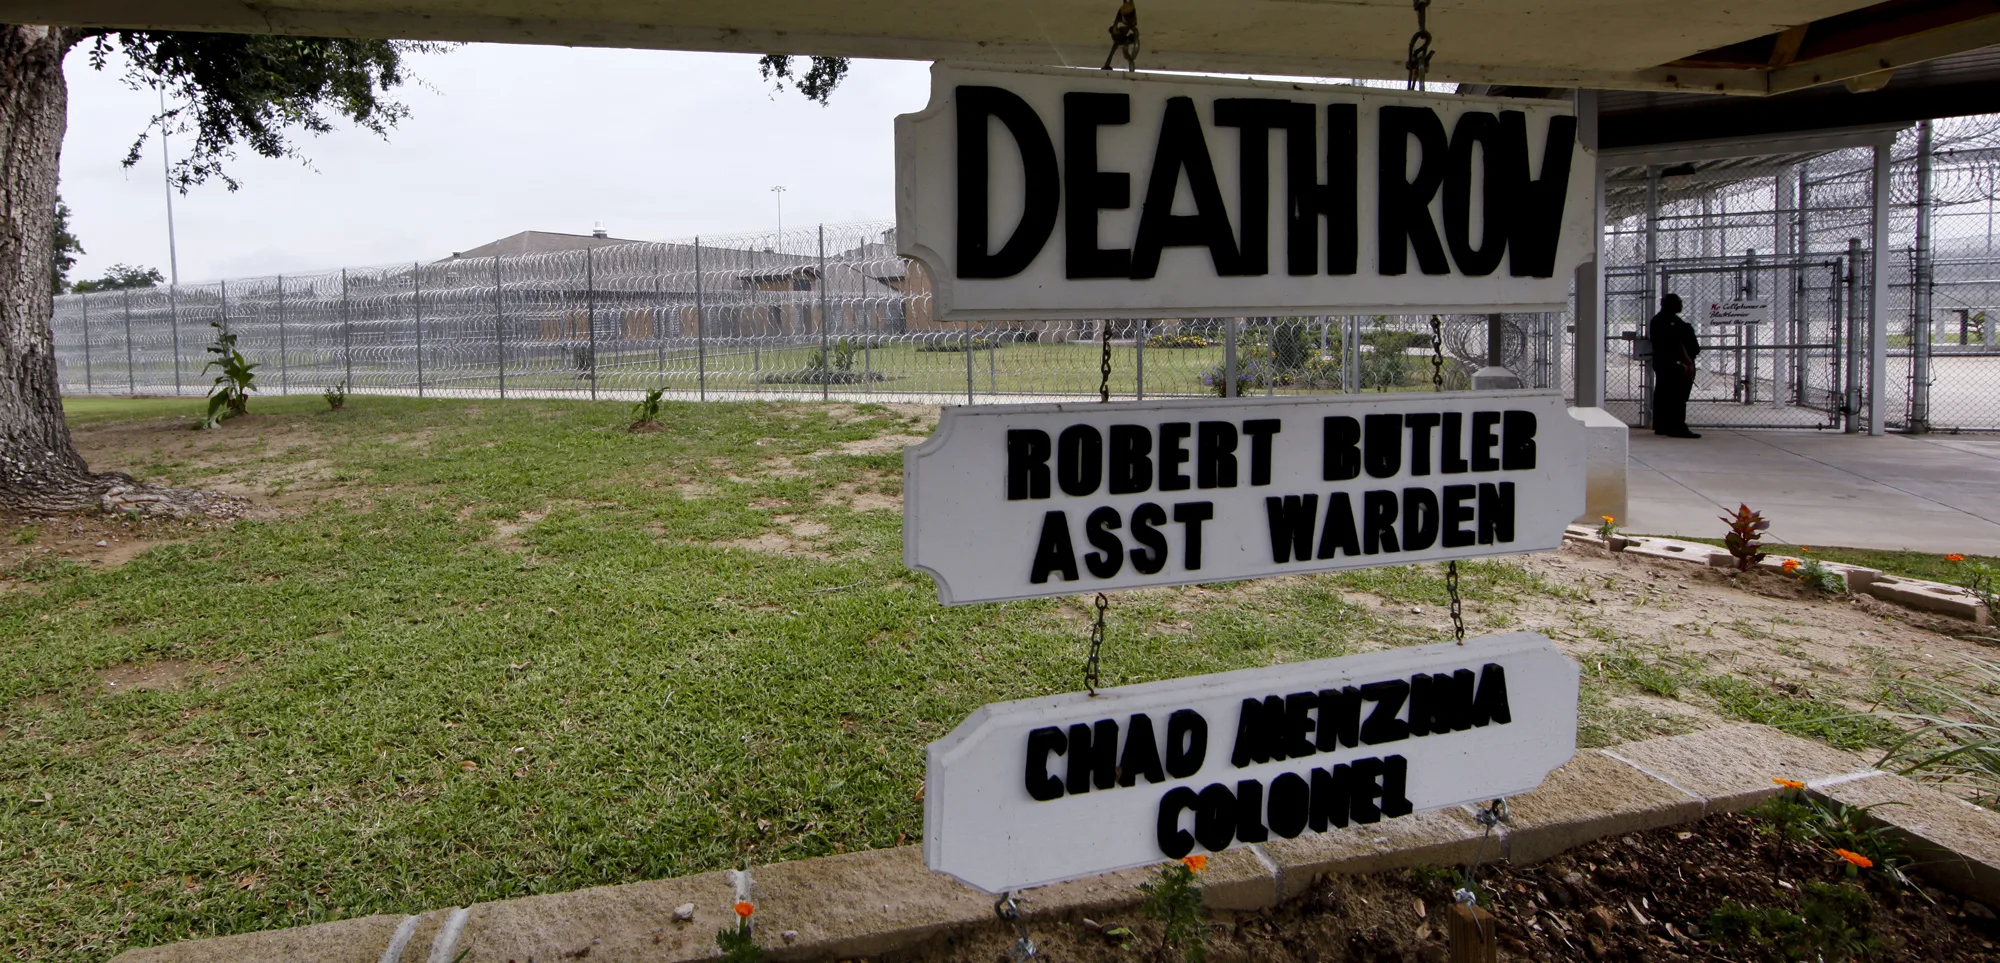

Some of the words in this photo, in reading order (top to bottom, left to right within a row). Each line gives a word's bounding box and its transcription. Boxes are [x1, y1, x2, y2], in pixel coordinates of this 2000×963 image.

[955, 85, 1358, 280] DEATH
[1378, 104, 1577, 278] ROW
[1007, 418, 1281, 500] ROBERT
[1323, 410, 1538, 481] BUTLER
[1029, 501, 1213, 584] ASST
[1266, 481, 1515, 563] WARDEN
[1025, 708, 1208, 801] CHAD
[1156, 754, 1414, 860] COLONEL
